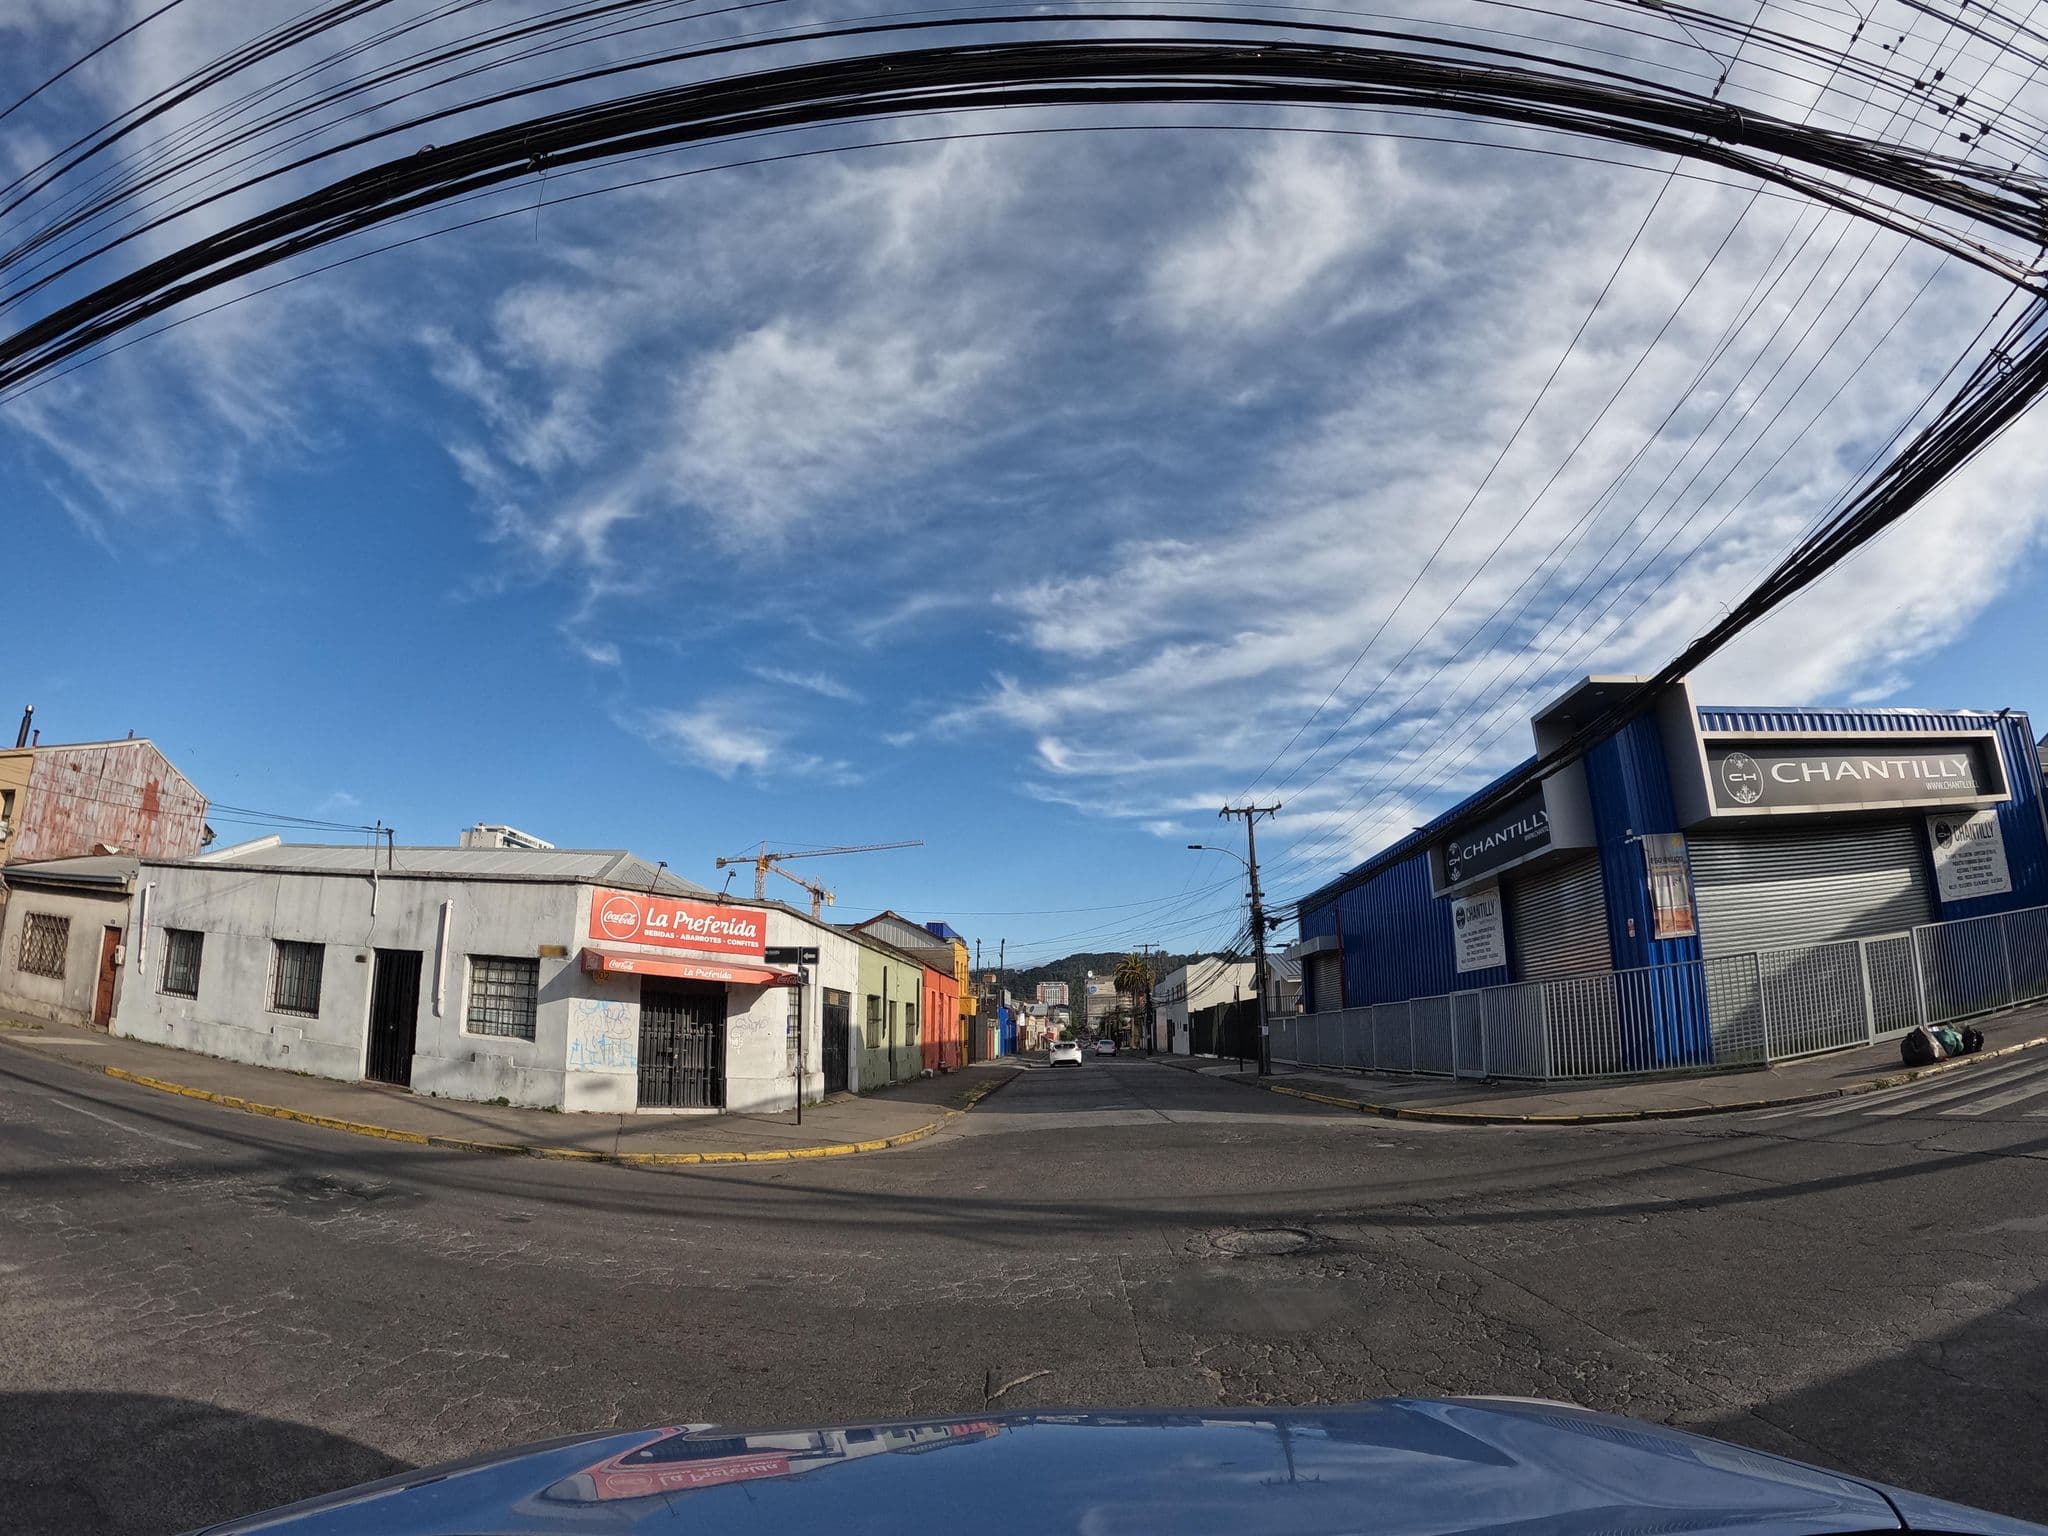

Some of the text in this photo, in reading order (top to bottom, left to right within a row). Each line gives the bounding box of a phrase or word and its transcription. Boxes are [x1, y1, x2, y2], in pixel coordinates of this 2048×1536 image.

[1729, 772, 1757, 782] CH
[1771, 758, 1970, 783] CHANTILLY
[1463, 810, 1550, 860] CHANTILLY
[1952, 821, 1994, 842] CHANTILLY
[646, 907, 757, 938] La Preferida
[644, 929, 759, 948] BEBIDAS ABARROTES CONFITES
[683, 967, 732, 979] La Preferida
